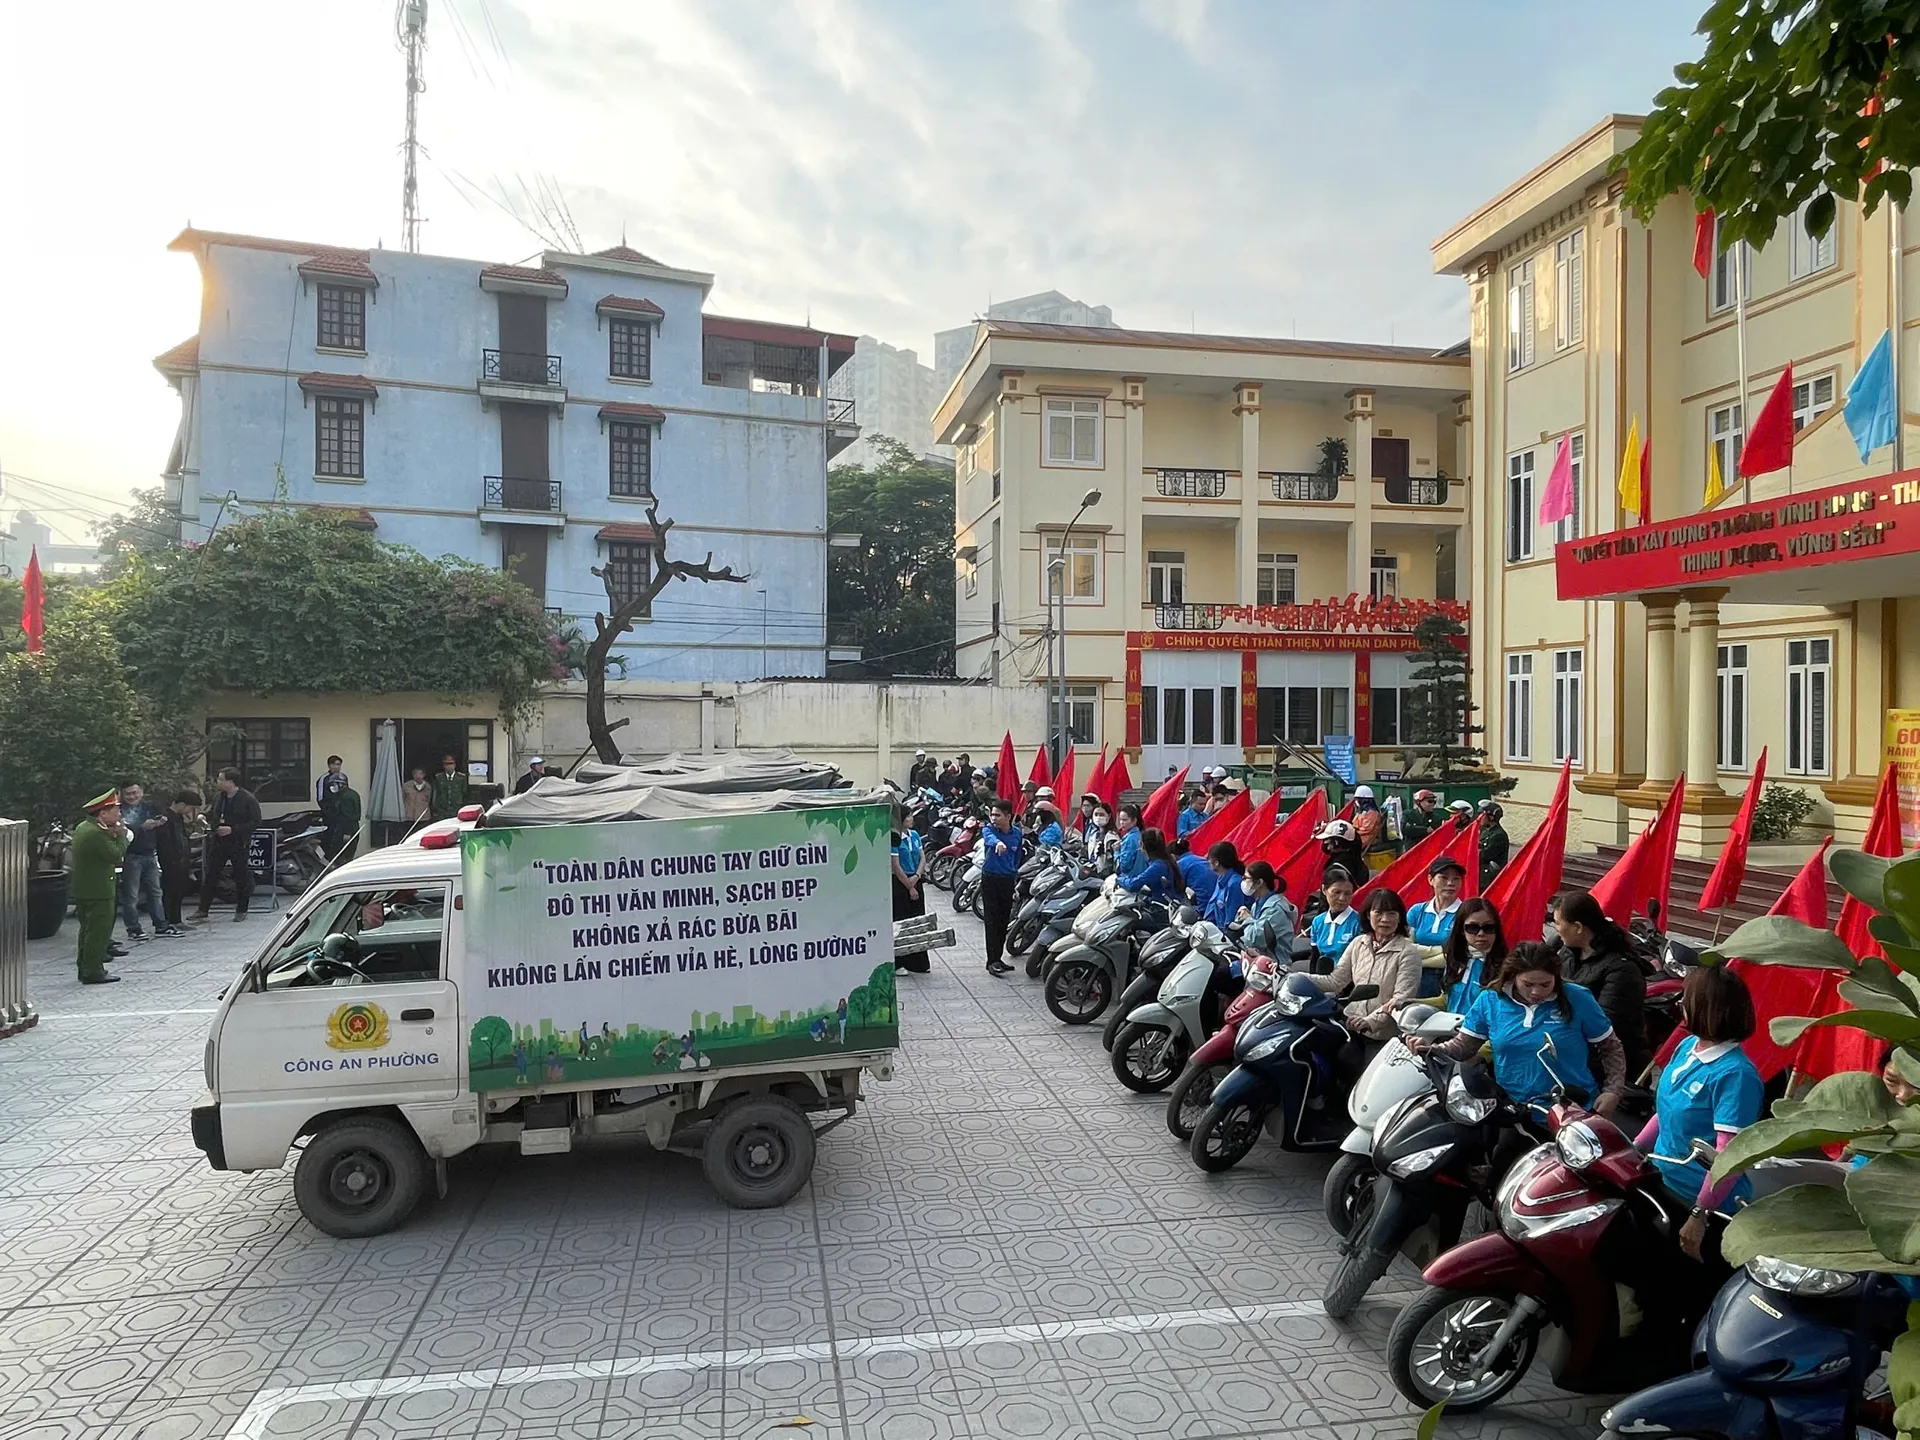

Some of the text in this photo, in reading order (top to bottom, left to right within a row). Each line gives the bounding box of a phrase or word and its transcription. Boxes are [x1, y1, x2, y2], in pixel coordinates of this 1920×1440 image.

[1642, 529, 1668, 551] XÂY
[1680, 550, 1722, 575] THỊNH
[1165, 634, 1204, 647] CHÍNH
[1324, 636, 1335, 648] VÌ
[533, 843, 828, 884] “TOÀN DÂN CHUNG TAY GIỮ GÌN
[547, 878, 818, 917] ĐÔ THỊ VĂN MINH, SẠCH ĐẸP
[572, 909, 798, 948] KHÔNG XẢ RÁC BỪA BÃI
[488, 930, 877, 988] KHÔNG LẤN CHIẾM VỈA HÈ, LÒNG ĐƯỜNG”
[284, 1051, 439, 1073] CÔNG AN PHƯỜNG
